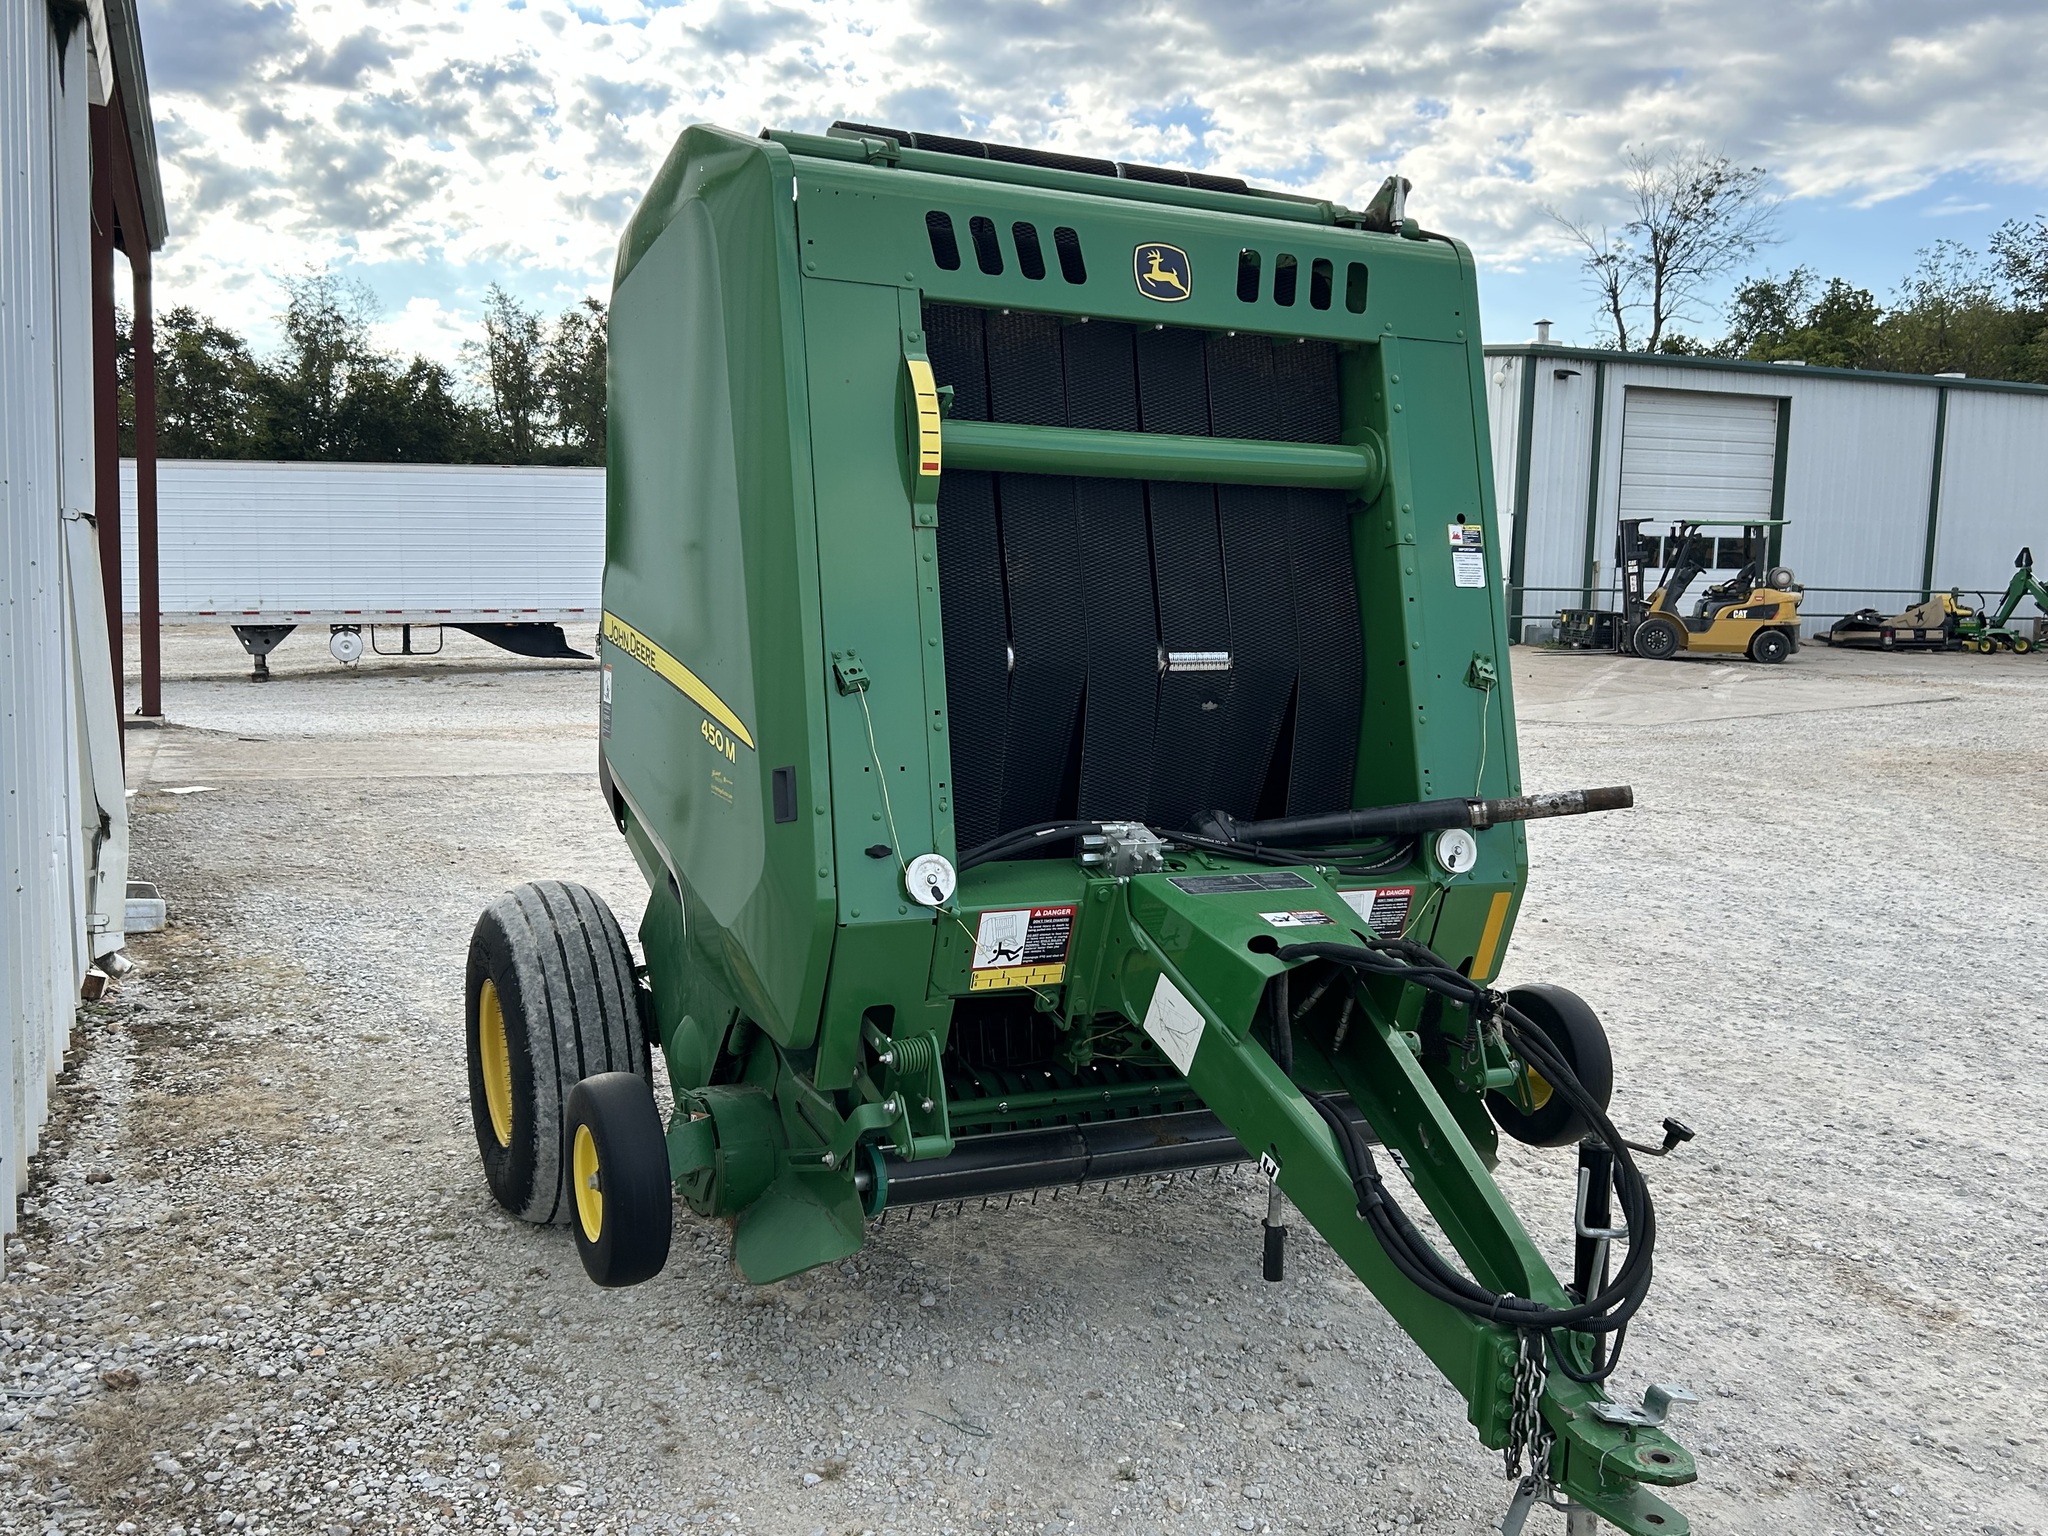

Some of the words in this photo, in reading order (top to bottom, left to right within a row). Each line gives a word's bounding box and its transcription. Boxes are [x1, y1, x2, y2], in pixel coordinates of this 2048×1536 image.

[1733, 609, 1748, 619] CAT
[608, 620, 629, 650] JOHN
[629, 632, 656, 669] DEERE
[701, 718, 724, 753] 450
[724, 736, 736, 764] M
